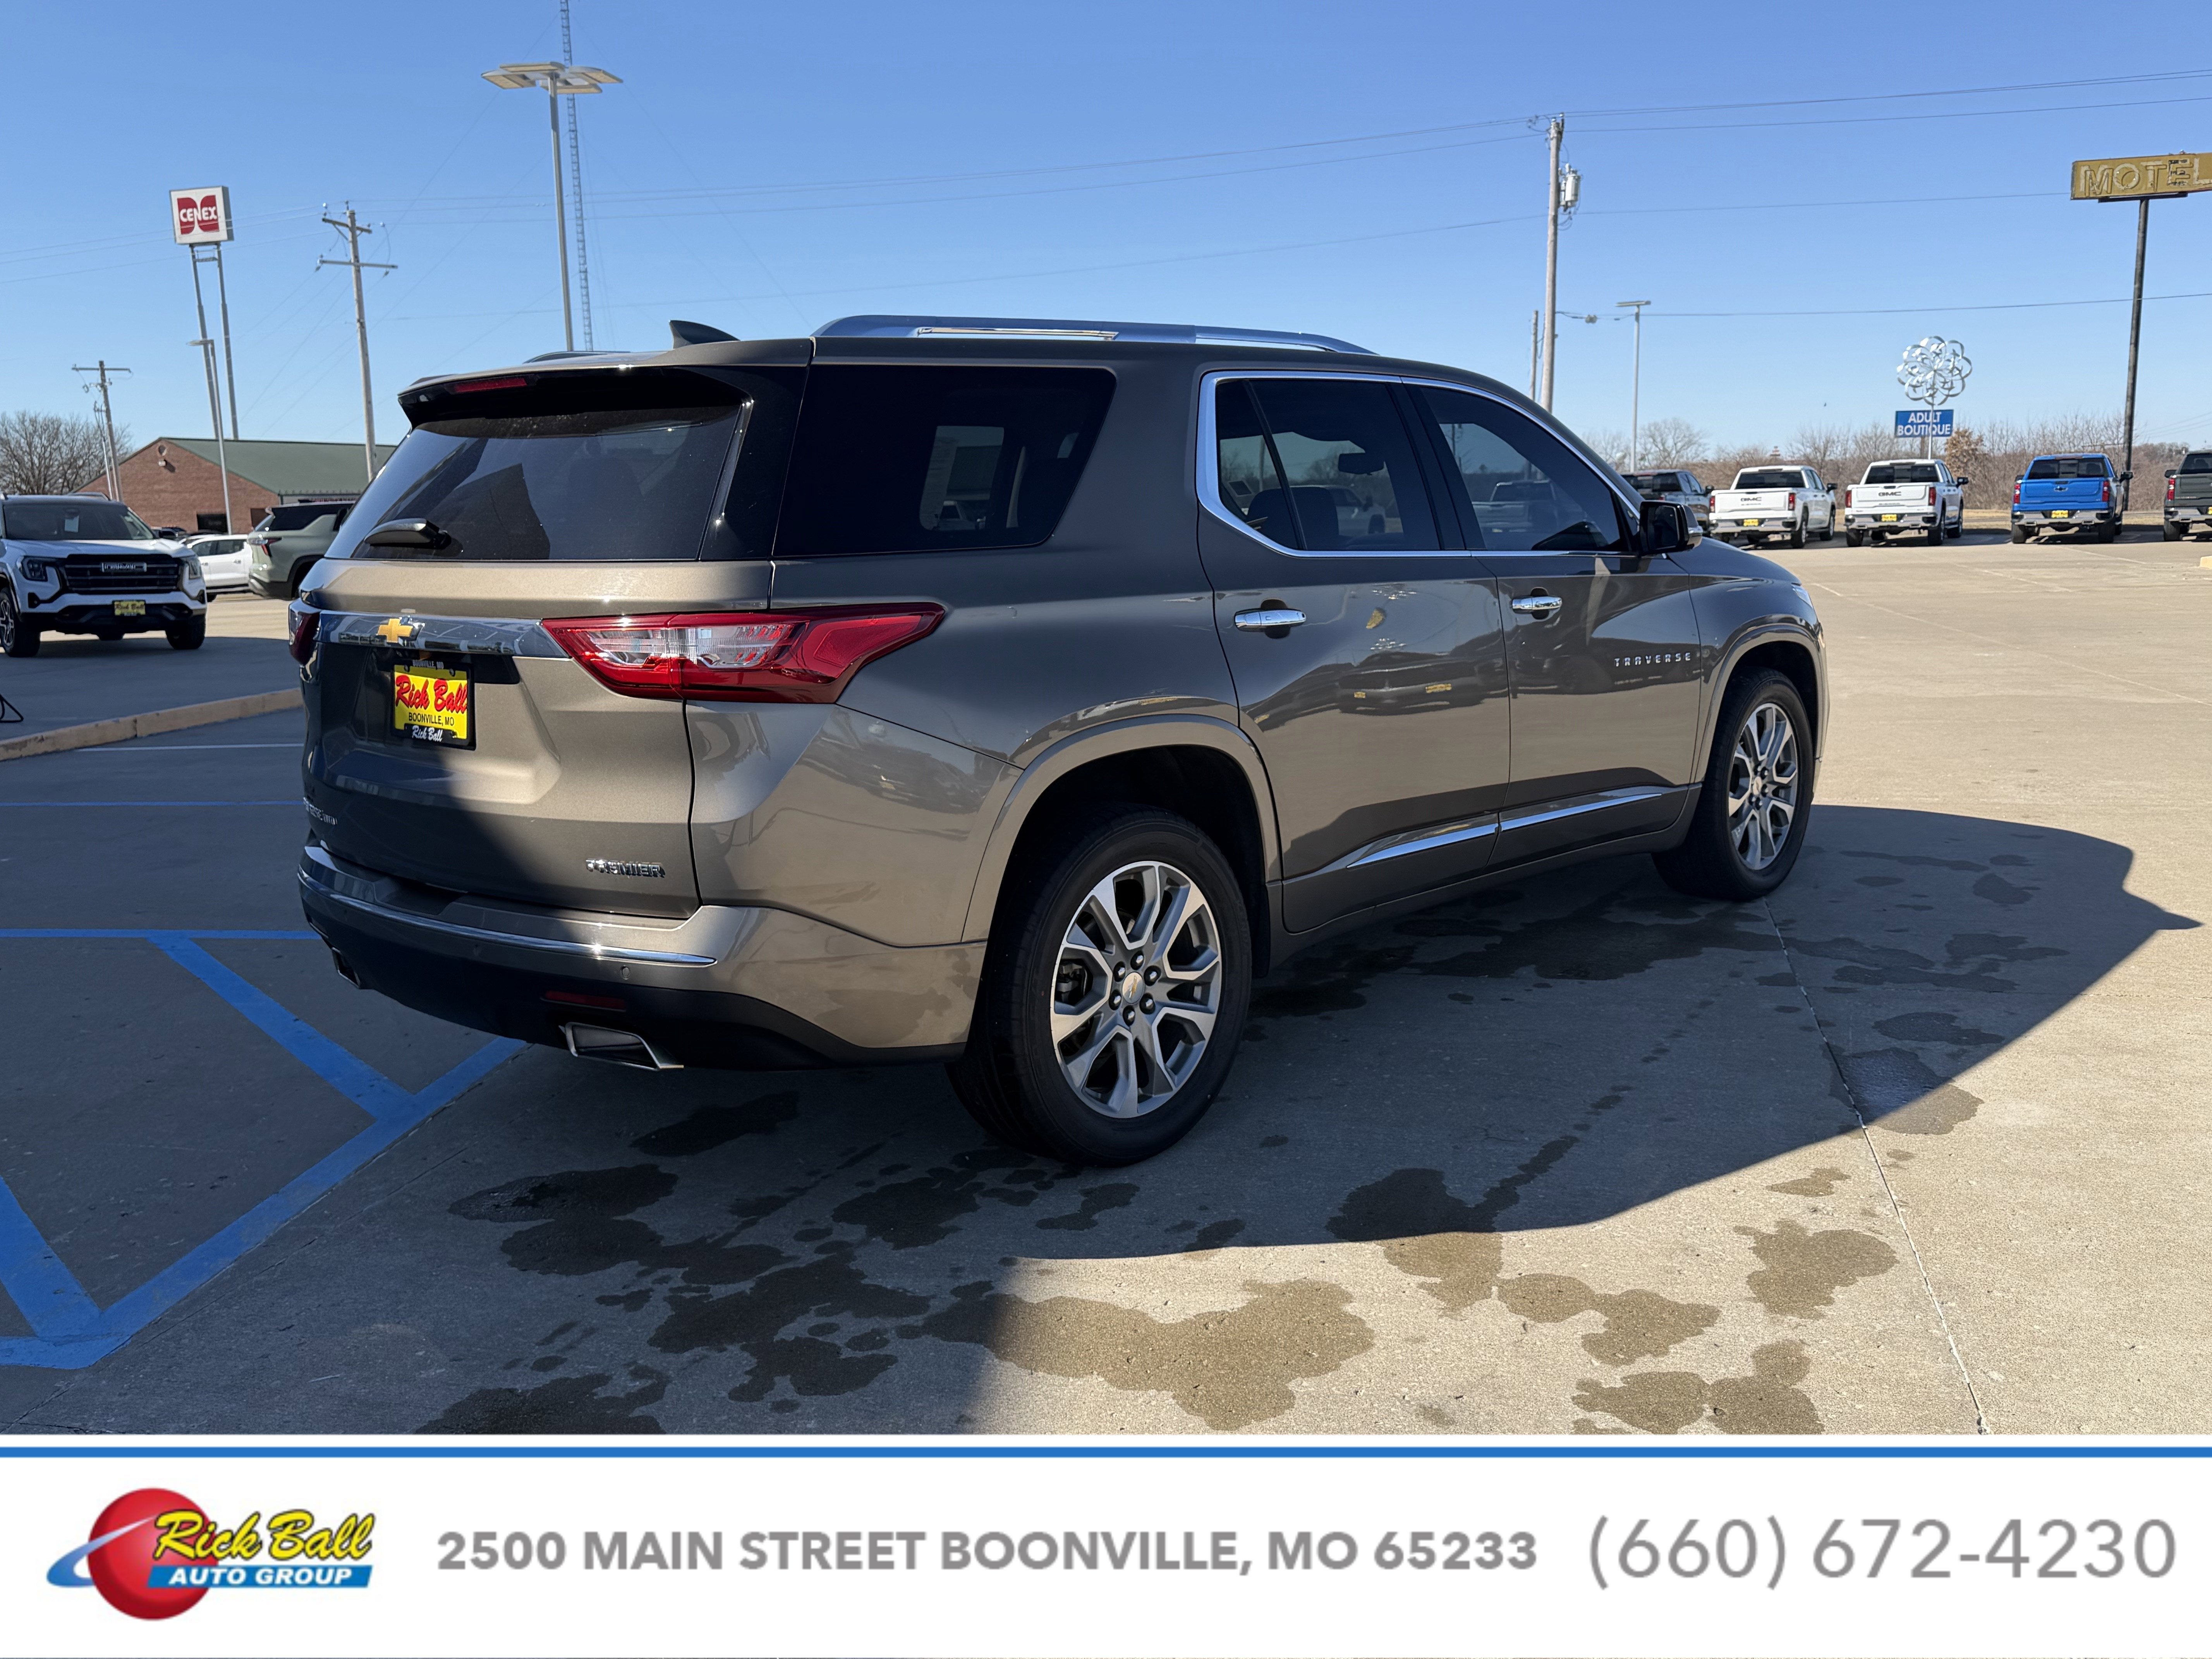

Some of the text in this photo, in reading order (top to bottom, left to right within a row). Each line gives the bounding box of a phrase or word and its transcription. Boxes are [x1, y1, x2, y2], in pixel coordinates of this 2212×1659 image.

[2080, 158, 2212, 196] MOTEL
[180, 206, 218, 223] CENEX
[1908, 411, 1942, 423] ADULT
[1898, 424, 1951, 436] BOUTIQUE
[1614, 653, 1691, 667] TRAVERSE
[395, 675, 467, 714] Rick Ball
[409, 712, 454, 726] BOONVILLE, MO
[412, 725, 443, 742] Rick Ball
[586, 858, 665, 878] PREMIER
